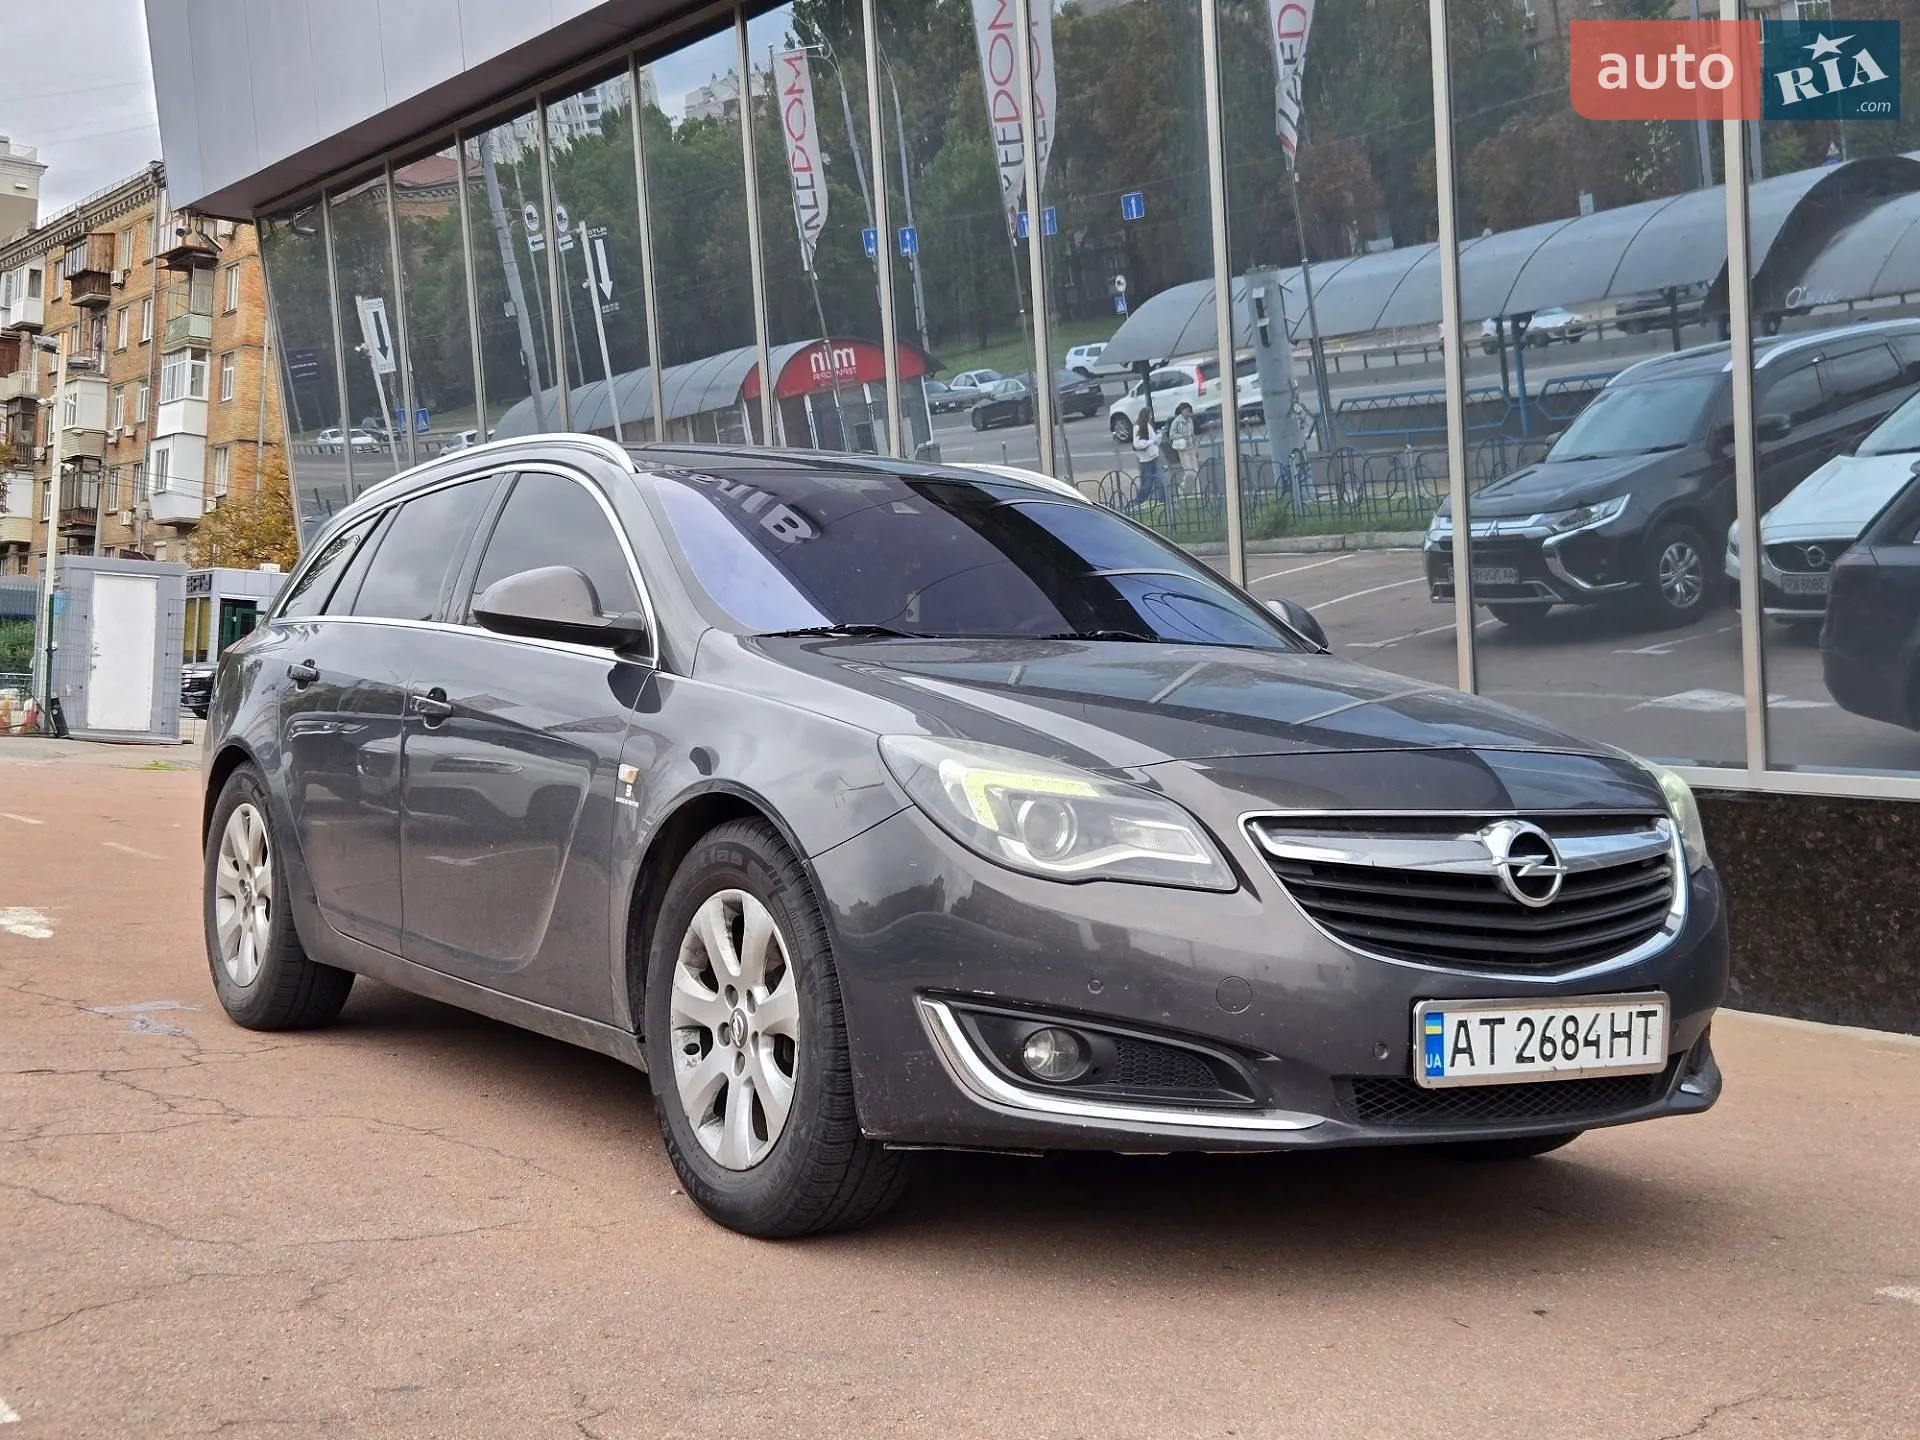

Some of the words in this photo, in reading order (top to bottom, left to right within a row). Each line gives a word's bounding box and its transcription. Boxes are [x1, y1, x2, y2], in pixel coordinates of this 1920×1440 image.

[1449, 1017, 1506, 1068] AT
[1514, 1012, 1601, 1065] 2684
[1608, 1009, 1658, 1059] HT
[1425, 1053, 1442, 1069] UA
